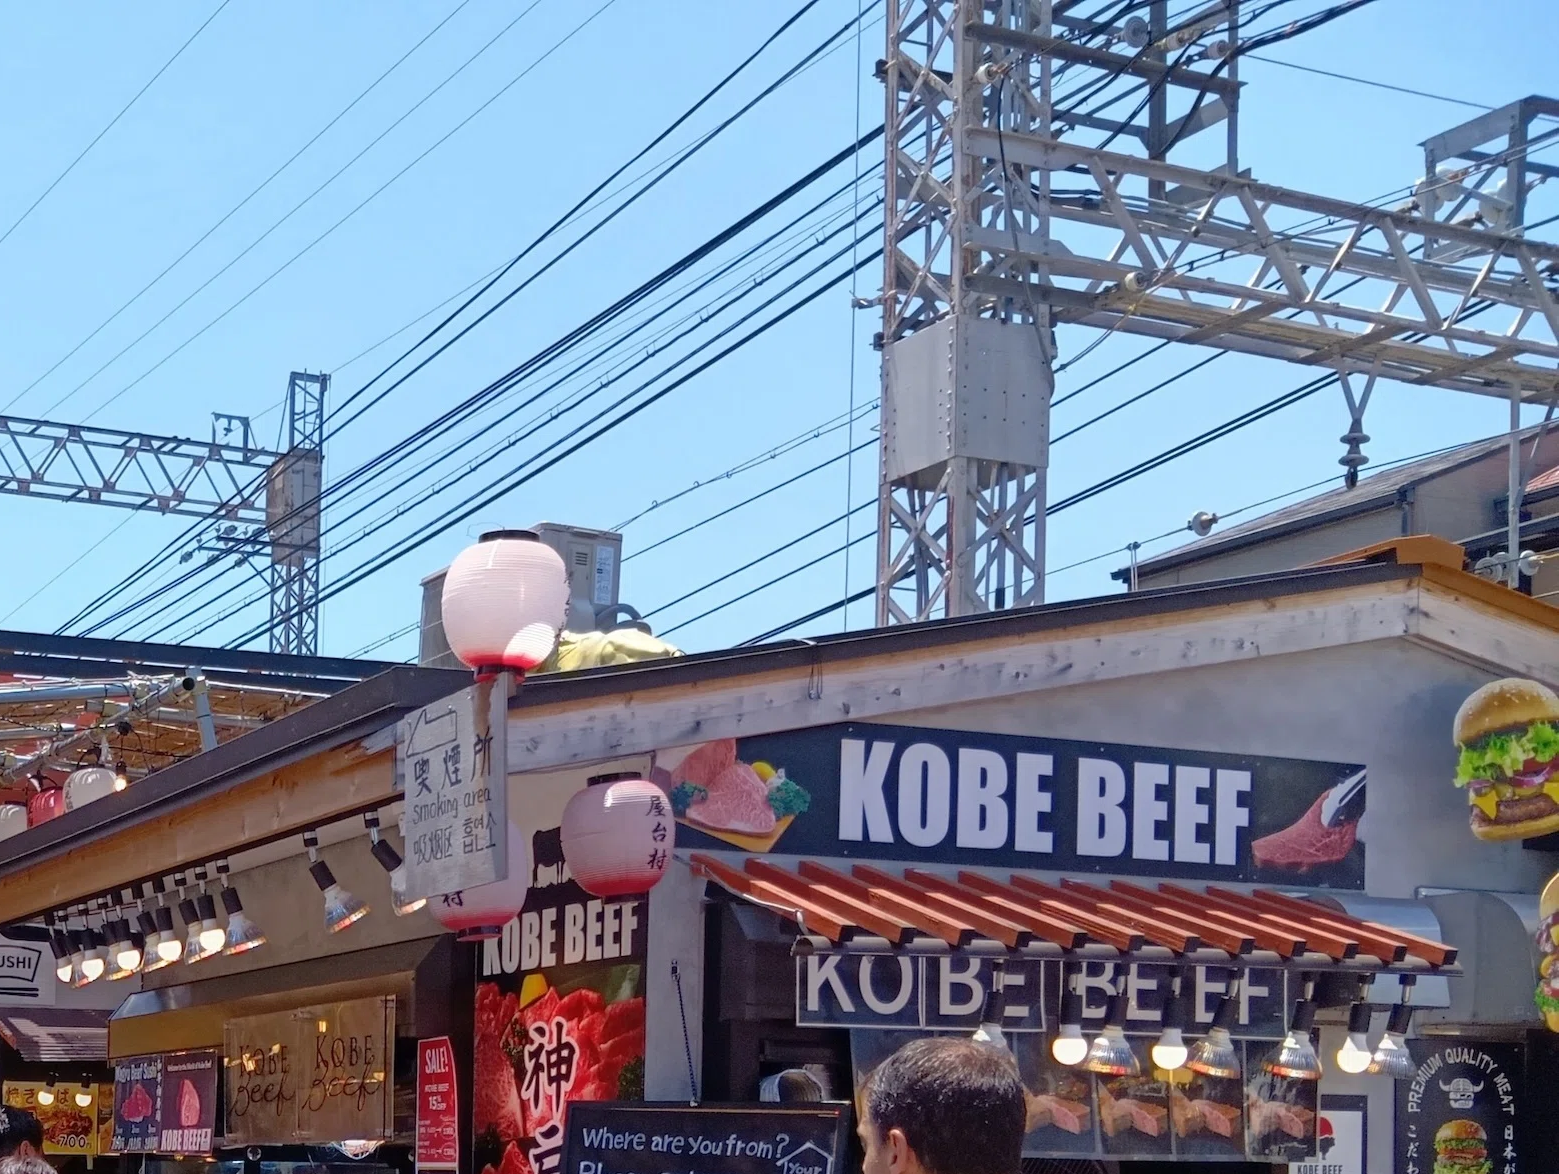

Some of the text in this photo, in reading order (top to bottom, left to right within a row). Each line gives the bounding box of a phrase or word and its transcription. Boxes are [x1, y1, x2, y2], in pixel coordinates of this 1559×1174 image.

[414, 725, 494, 798] 喫煙所
[463, 788, 492, 808] area
[838, 738, 1252, 866] KOBE BEEF
[646, 795, 667, 871] 屋台村
[482, 899, 639, 977] KOBE BEEF
[806, 955, 1270, 1025] KOBE BEEF
[315, 1034, 373, 1072] KOBE
[425, 1046, 449, 1074] SALE!
[1445, 1047, 1498, 1074] QUALITY
[6, 1087, 70, 1105] 焼きば
[1407, 1053, 1444, 1113] PREMIUM
[1493, 1072, 1515, 1116] MEAT
[161, 1129, 182, 1151] KOBE
[582, 1126, 646, 1149] Where
[651, 1134, 685, 1154] are
[725, 1133, 790, 1160] from?
